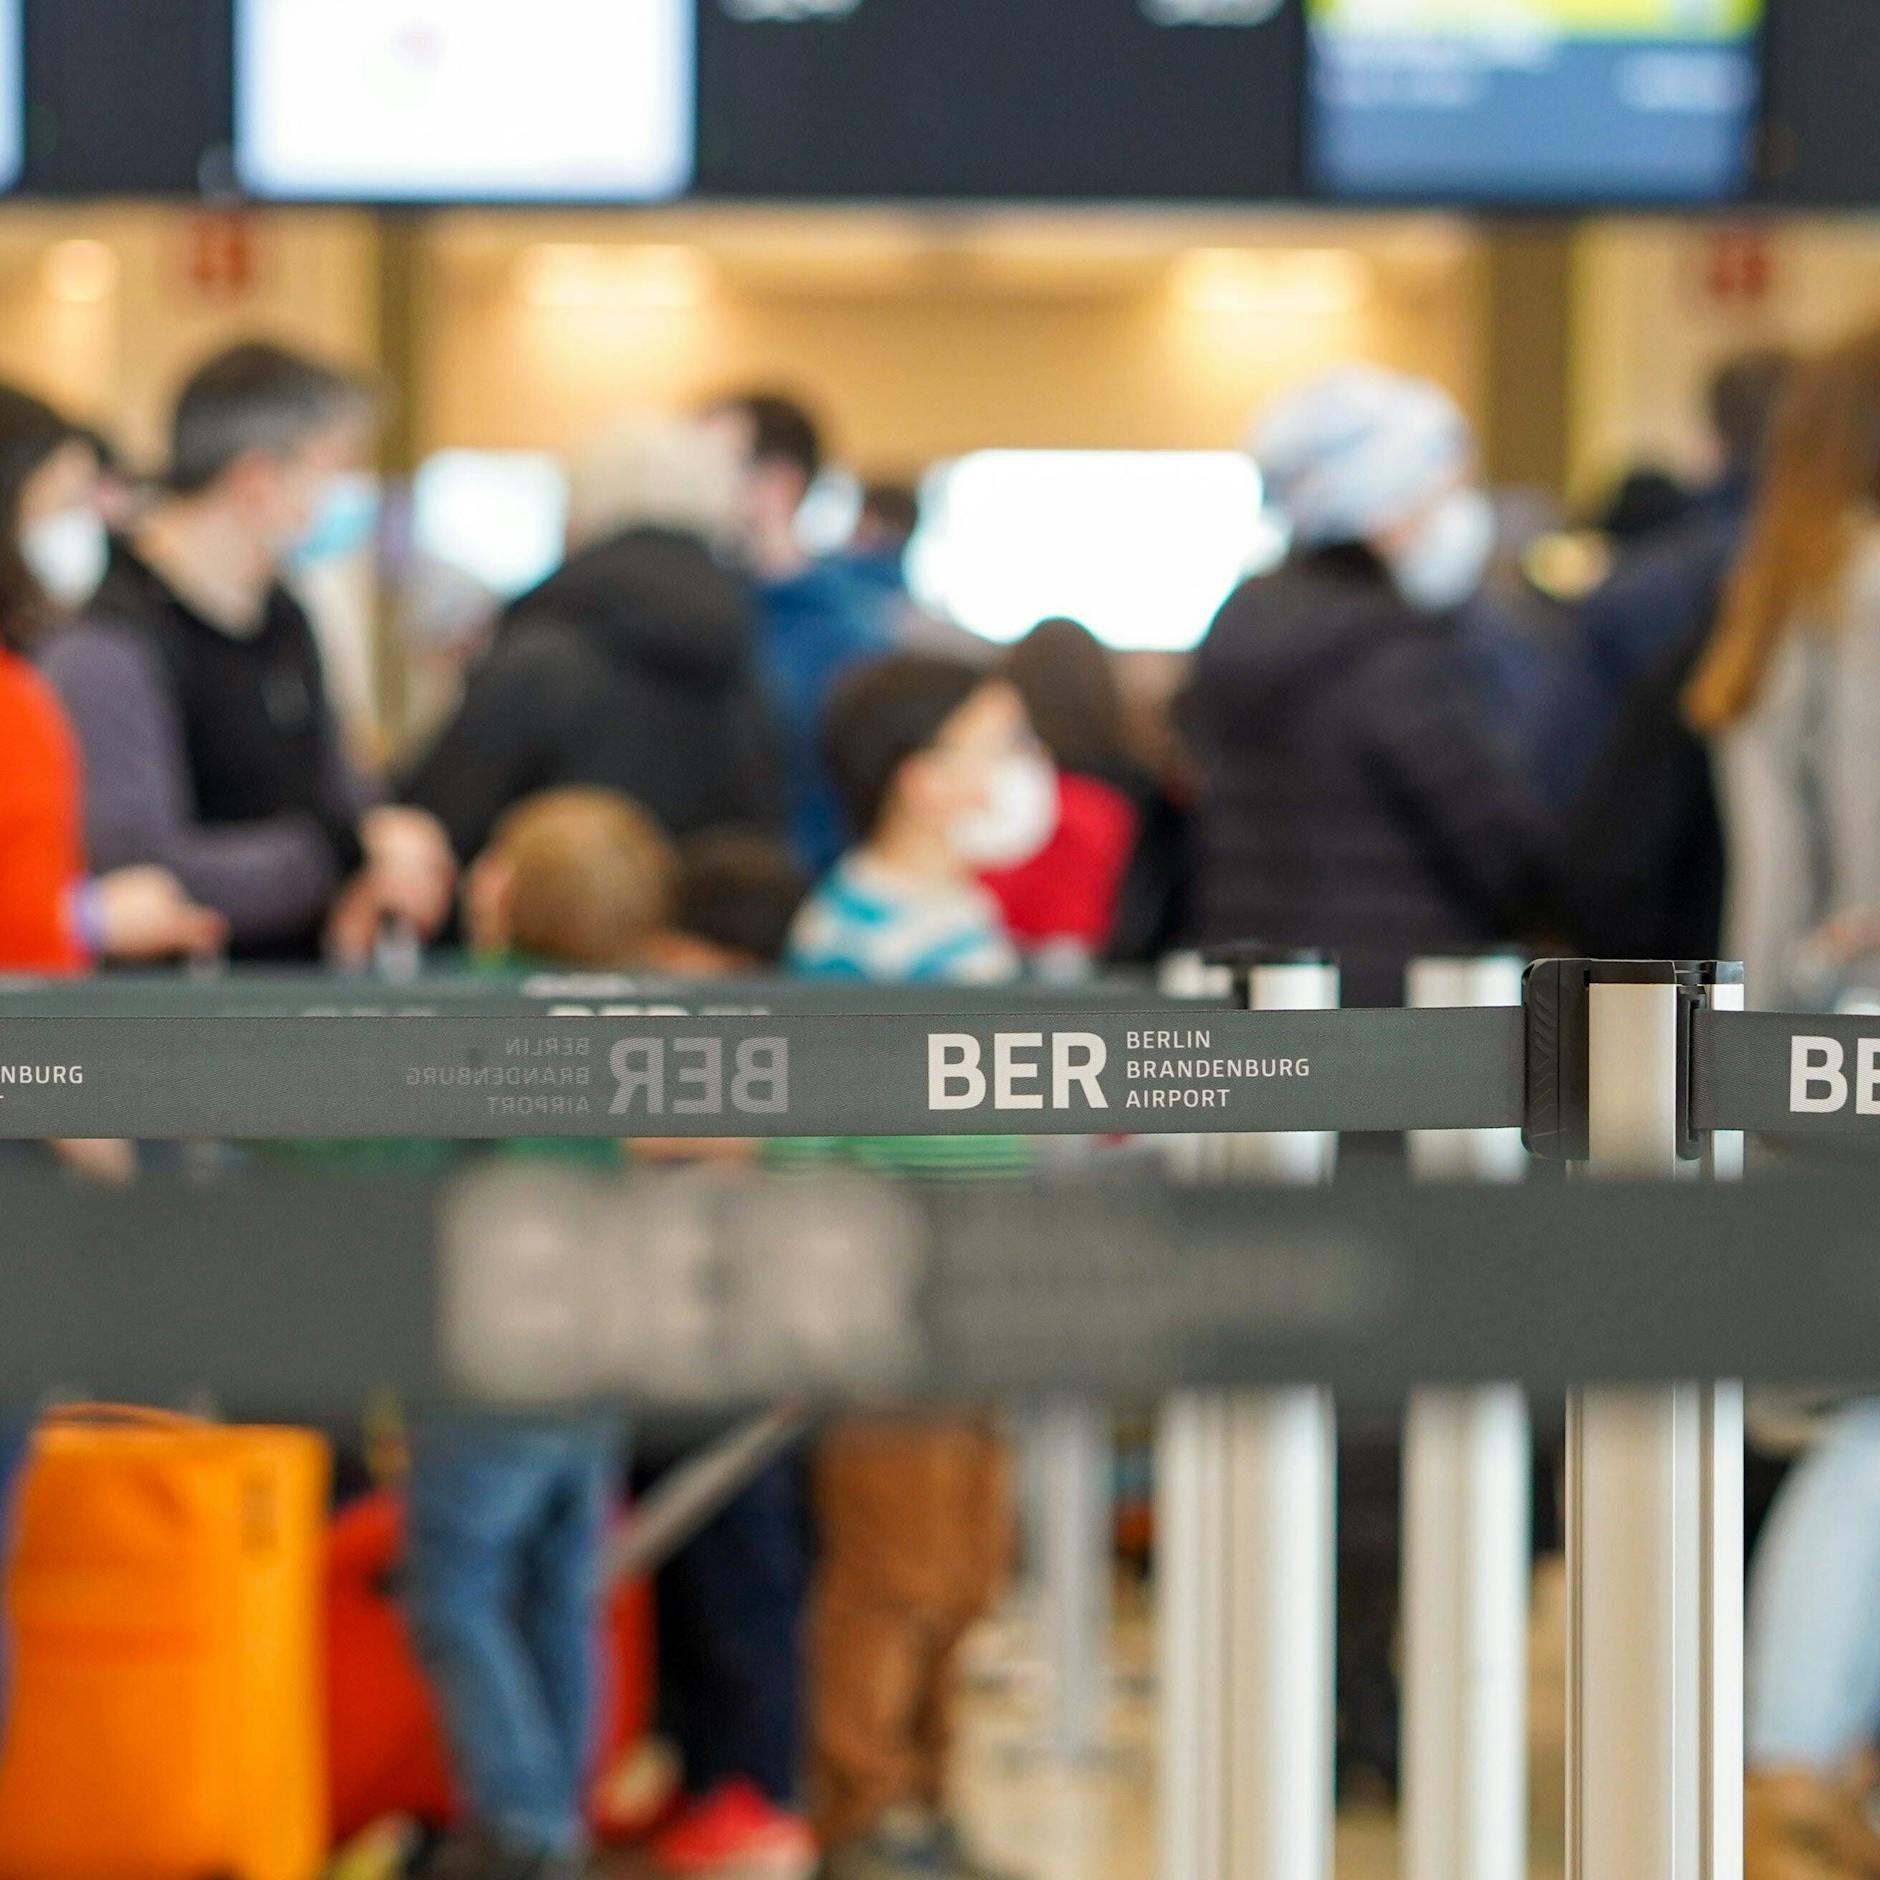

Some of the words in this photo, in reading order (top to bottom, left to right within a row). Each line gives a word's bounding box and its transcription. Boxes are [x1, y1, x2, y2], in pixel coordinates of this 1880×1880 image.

[1126, 1030, 1211, 1049] BERLIN
[1, 1065, 83, 1084] NBURG
[928, 1032, 1108, 1110] BER
[1126, 1058, 1310, 1078] BRANDENBURG
[1126, 1089, 1230, 1108] AIRPORT
